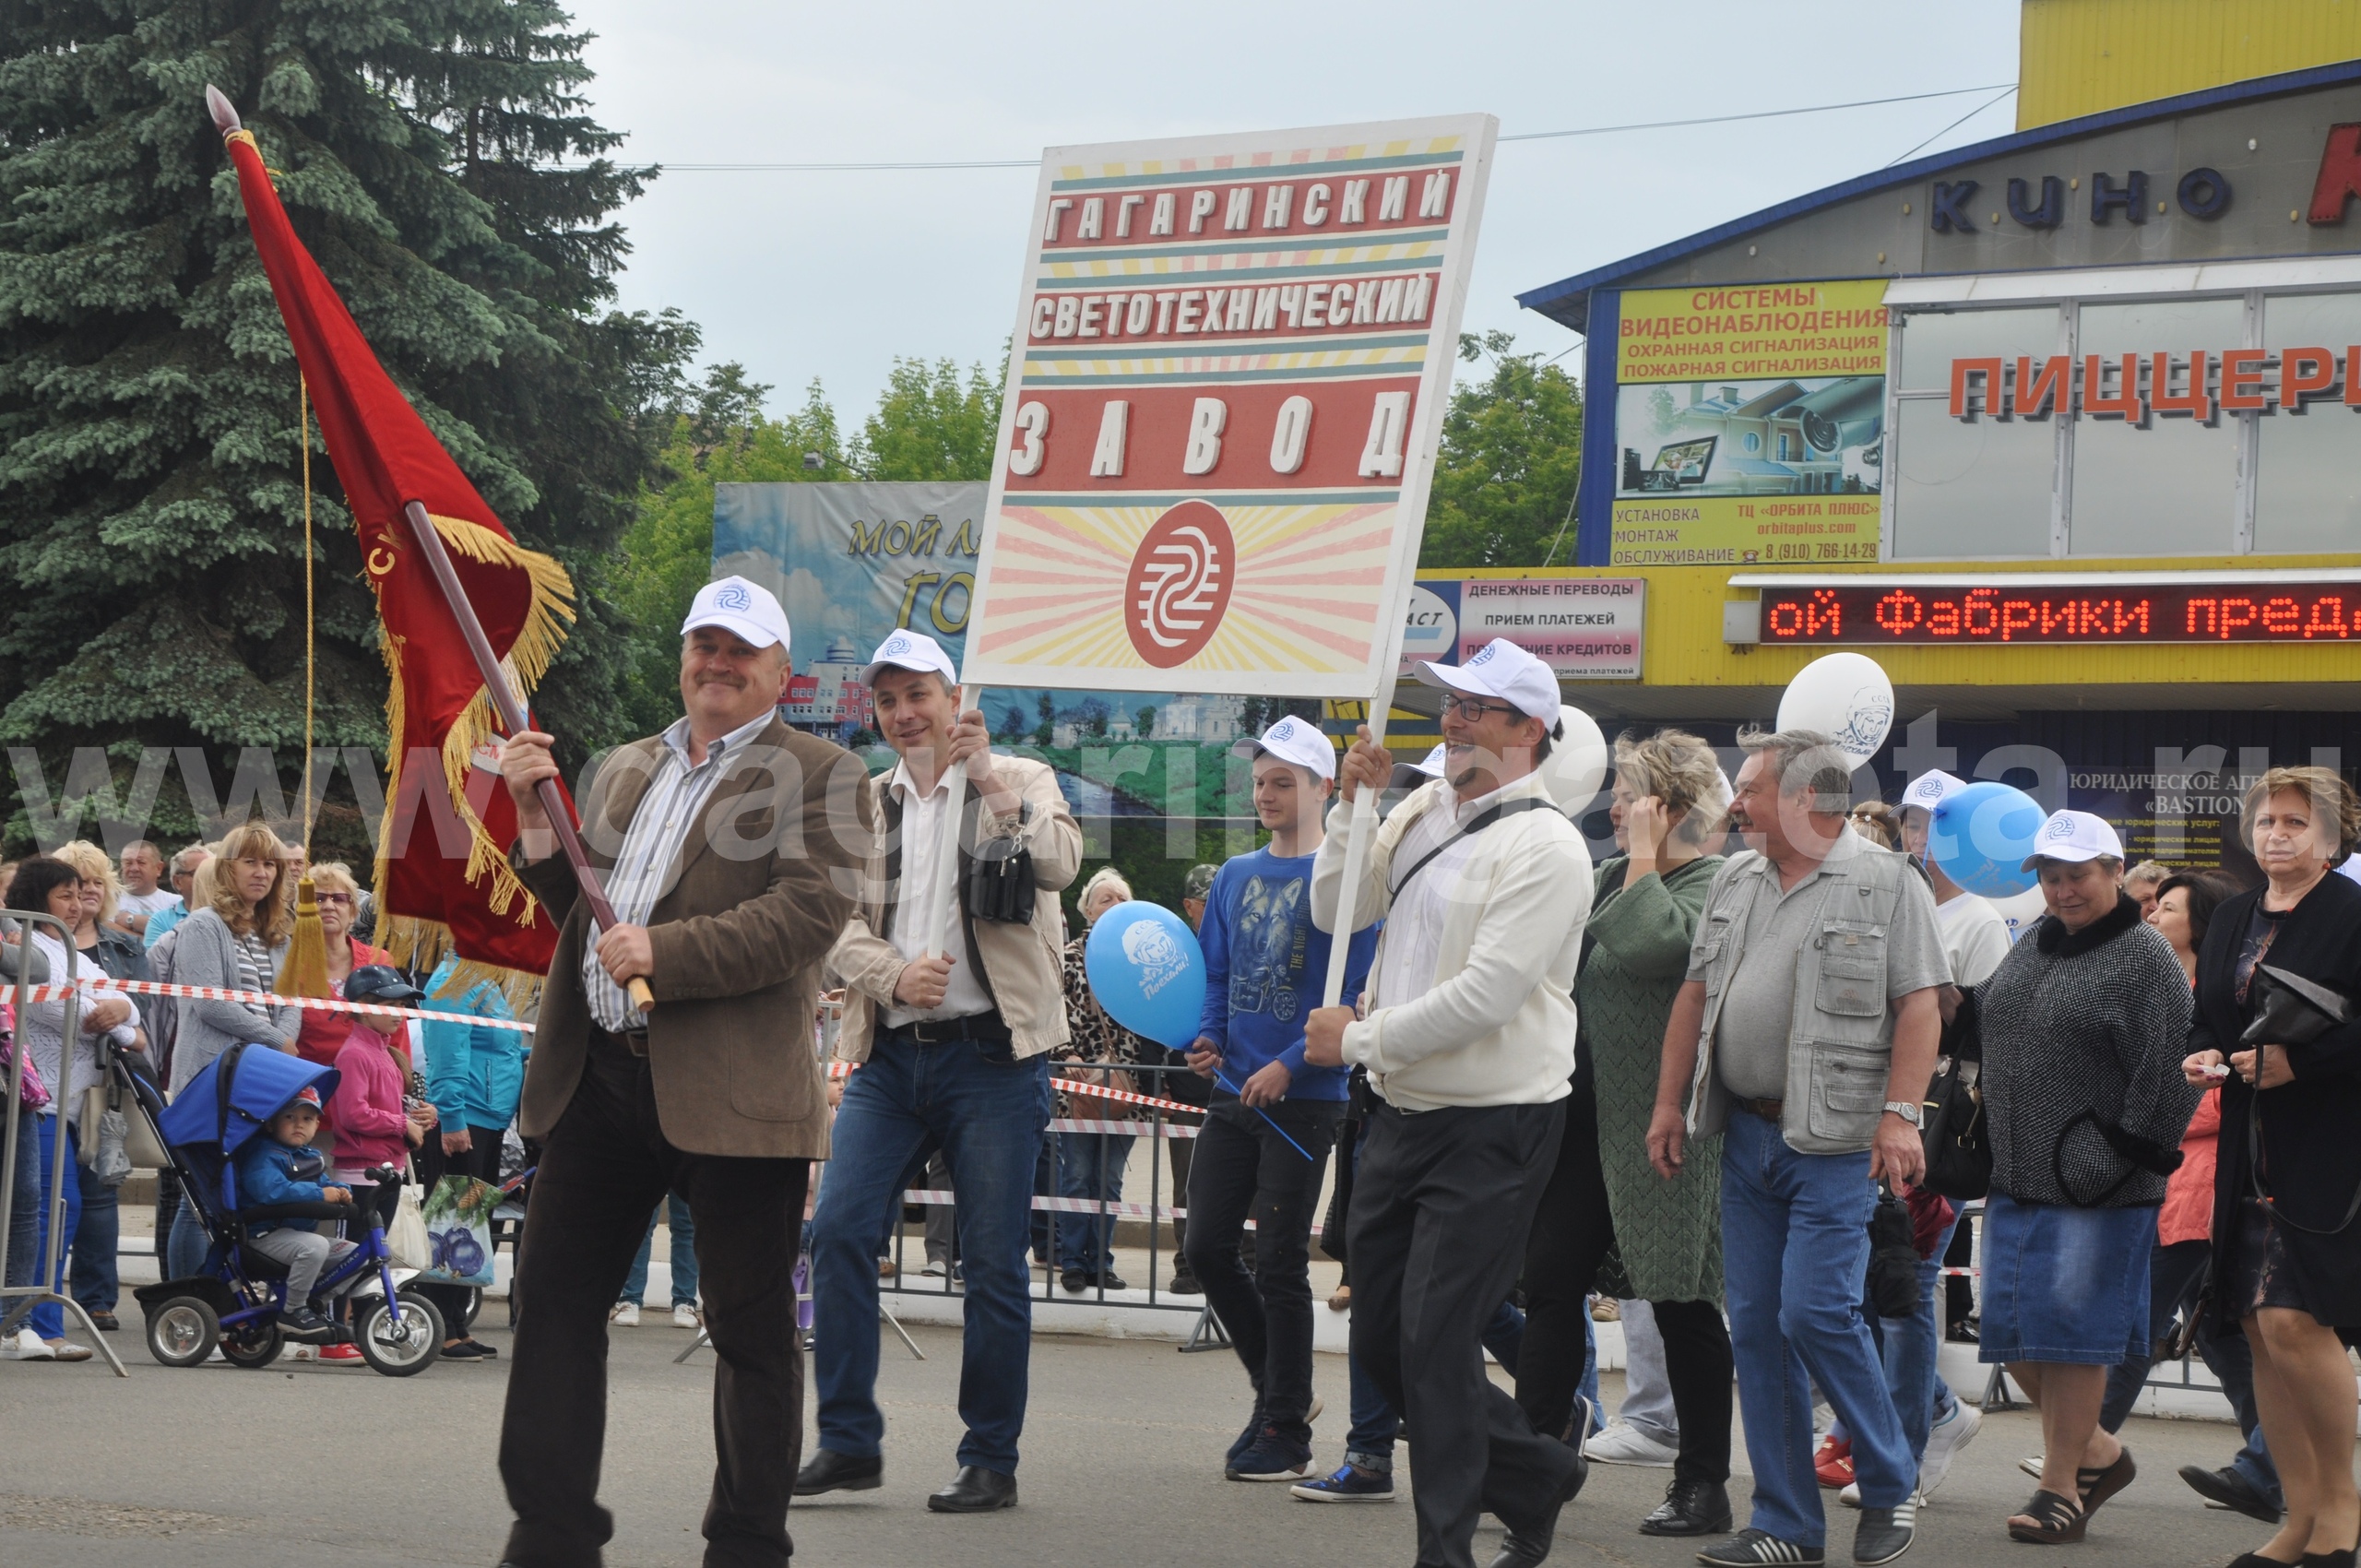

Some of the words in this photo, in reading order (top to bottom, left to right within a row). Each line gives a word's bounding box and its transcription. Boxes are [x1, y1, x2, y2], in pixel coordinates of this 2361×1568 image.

[1045, 170, 1451, 241] ГАГАРИНСКИЙ
[1030, 273, 1433, 339] СВЕТОТЕХНИЧЕСКИЙ
[1691, 287, 1815, 311] СИСТЕМЫ
[1620, 309, 1889, 339] ВИДЕОНАБЛЮДЕНИЯ
[1628, 341, 1724, 358] ОХРАННАЯ
[1729, 336, 1879, 354] СИГНАЛИЗАЦИЯ
[1624, 361, 1726, 377] ПОЖАРНАЯ
[1731, 356, 1881, 374] СИГНАЛИЗАЦИЯ
[1009, 391, 1410, 478] ЗАВОД
[1616, 508, 1700, 522] УСТАНОВКА
[1738, 505, 1754, 518] ТЦ
[1761, 504, 1821, 517] «ОРБИТА
[1829, 503, 1879, 515] ПЛЮС»
[848, 515, 942, 555] МОЙ
[1615, 529, 1679, 543] МОНТАЖ
[1757, 522, 1856, 535] orbitaplus.com
[1614, 549, 1735, 564] ОБСЛУЖИВАНИЕ
[1766, 543, 1774, 559] 8
[1779, 543, 1810, 560] (910)
[1816, 542, 1877, 559] 766-14-29
[1469, 585, 1550, 597] ДЕНЕЖНЫЕ
[1554, 584, 1633, 597] ПЕРЕВОДЫ
[1485, 614, 1534, 625] ПРИЕМ
[1538, 612, 1615, 625] ПЛАТЕЖЕЙ
[1770, 589, 1841, 636] ой
[1876, 588, 2149, 640] Фабрики
[2187, 596, 2361, 638] пред
[1557, 644, 1632, 656] КРЕДИТОВ
[1554, 668, 1588, 676] приема
[1590, 666, 1634, 675] платежей
[2070, 773, 2220, 792] ЮРИДИЧЕСКОЕ
[2125, 819, 2189, 827] юридических
[2191, 820, 2220, 828] услуг:
[1293, 924, 1307, 951] NIGHT
[1290, 953, 1303, 968] THE
